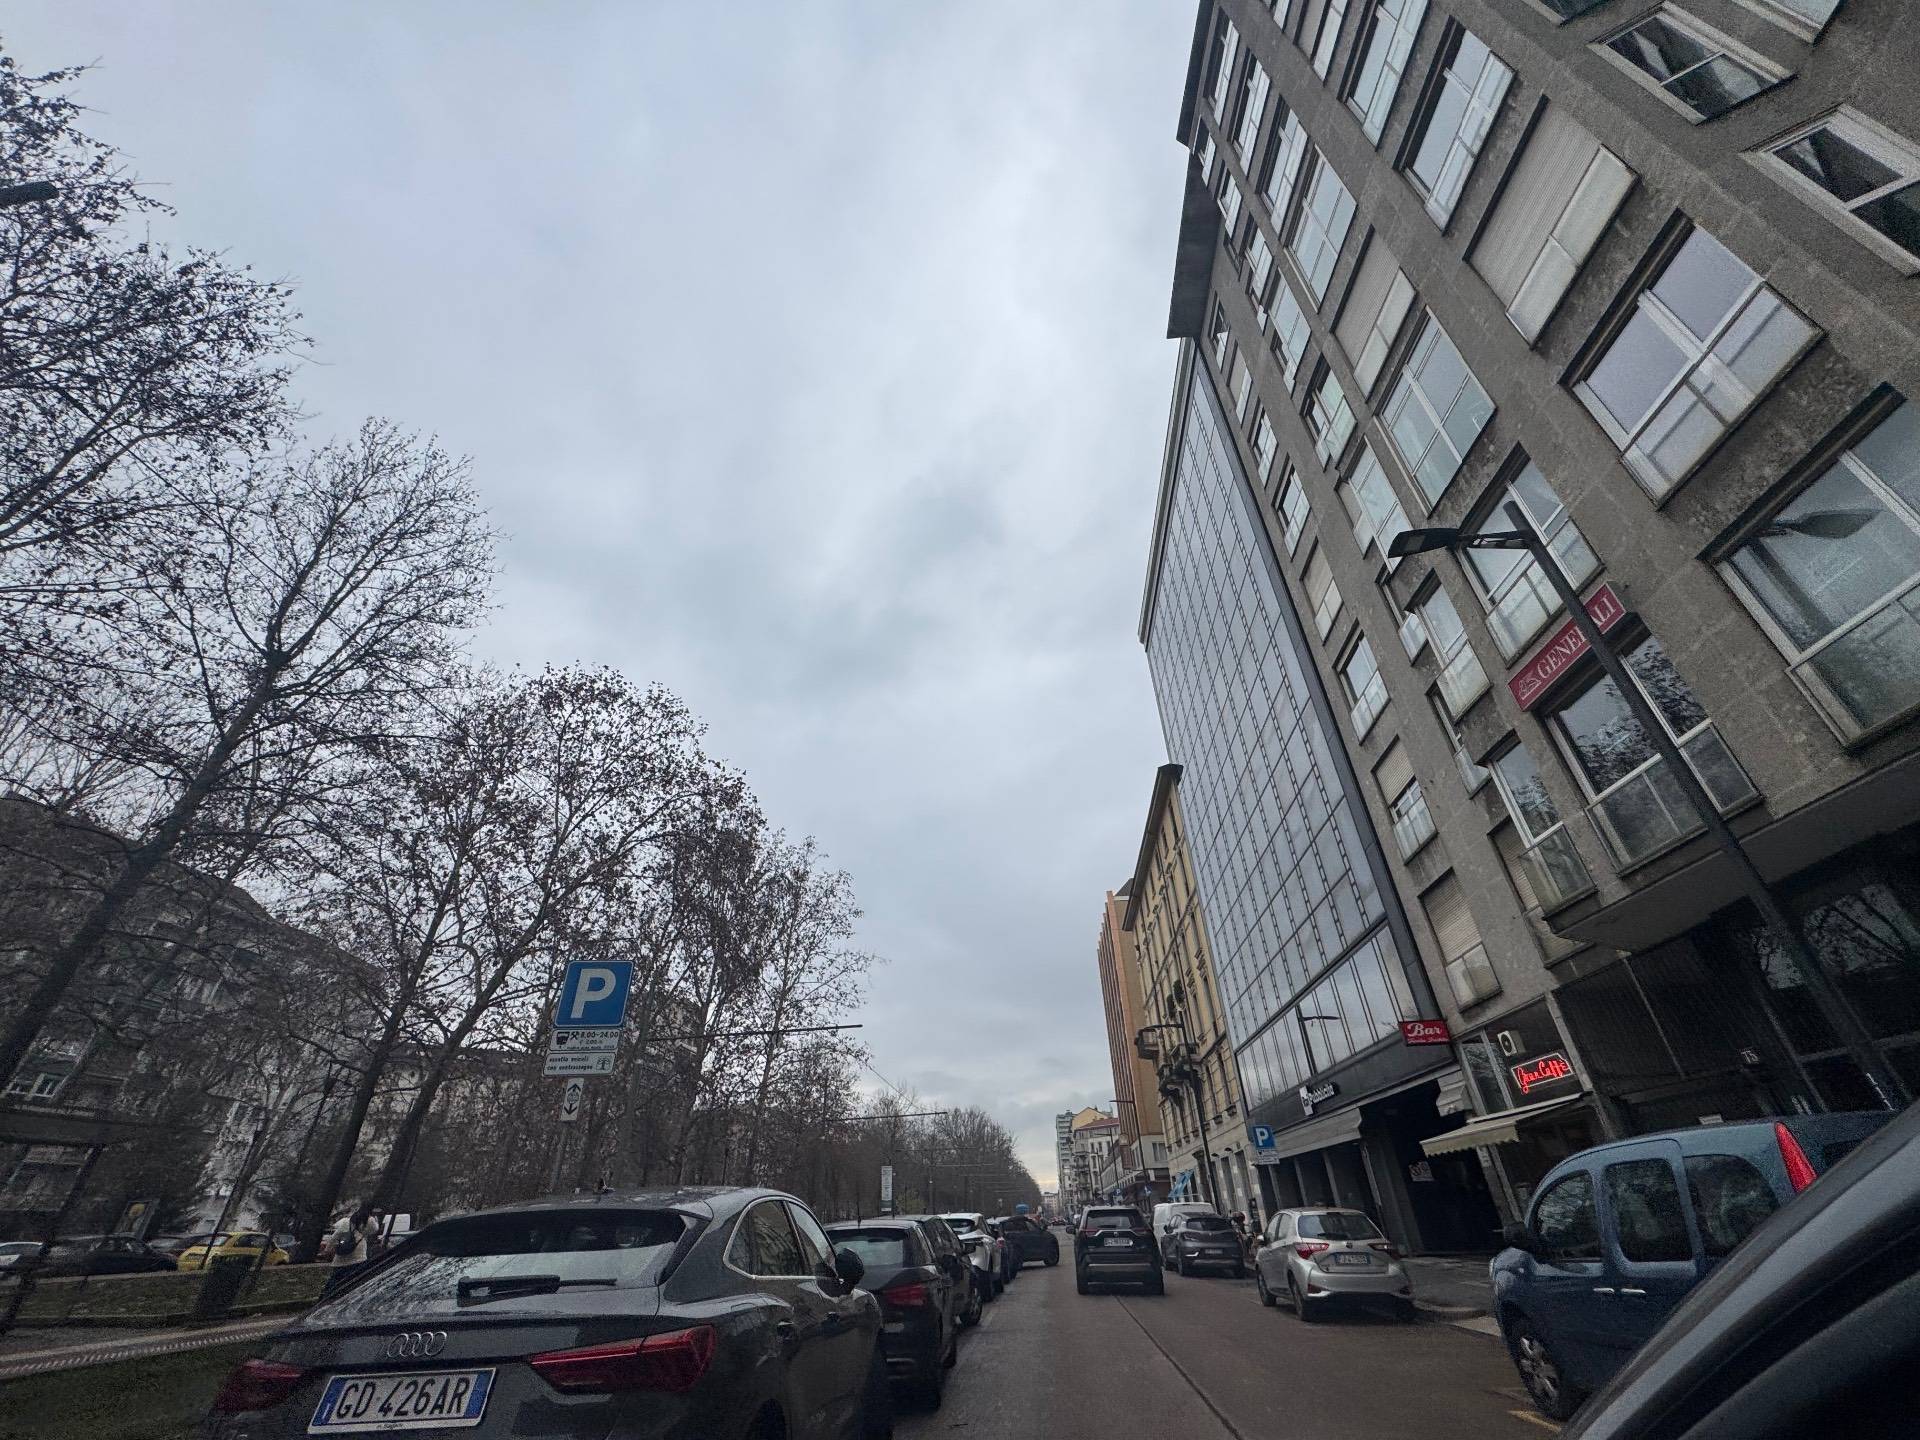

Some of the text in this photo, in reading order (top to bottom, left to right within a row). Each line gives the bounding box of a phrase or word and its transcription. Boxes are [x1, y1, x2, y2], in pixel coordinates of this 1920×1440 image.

[570, 968, 617, 1019] P
[1407, 1022, 1442, 1037] Bar
[1255, 1127, 1269, 1146] P
[336, 1382, 377, 1419] GD
[378, 1377, 471, 1418] 426AR
